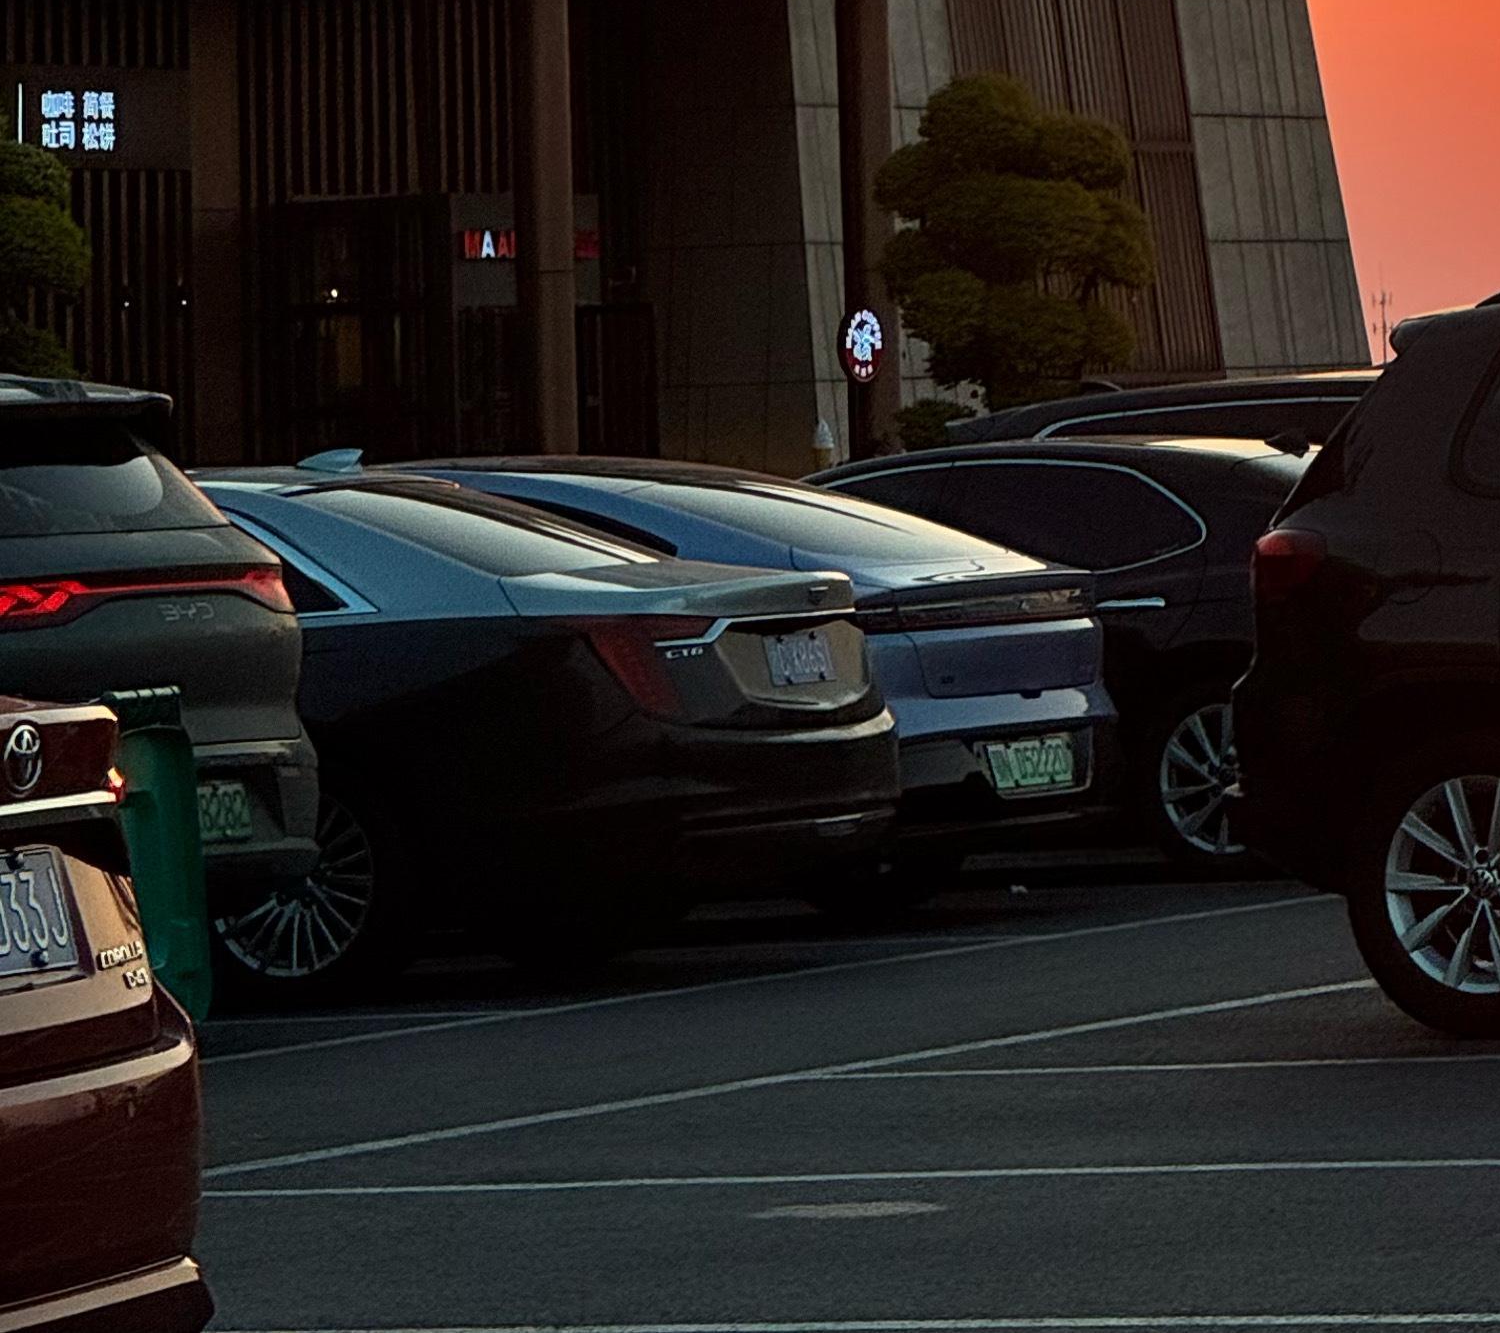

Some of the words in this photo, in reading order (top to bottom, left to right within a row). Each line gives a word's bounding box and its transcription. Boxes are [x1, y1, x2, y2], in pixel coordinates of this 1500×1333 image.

[42, 90, 75, 118] 咖啡
[42, 120, 75, 150] 吐司
[159, 602, 214, 621] BYD
